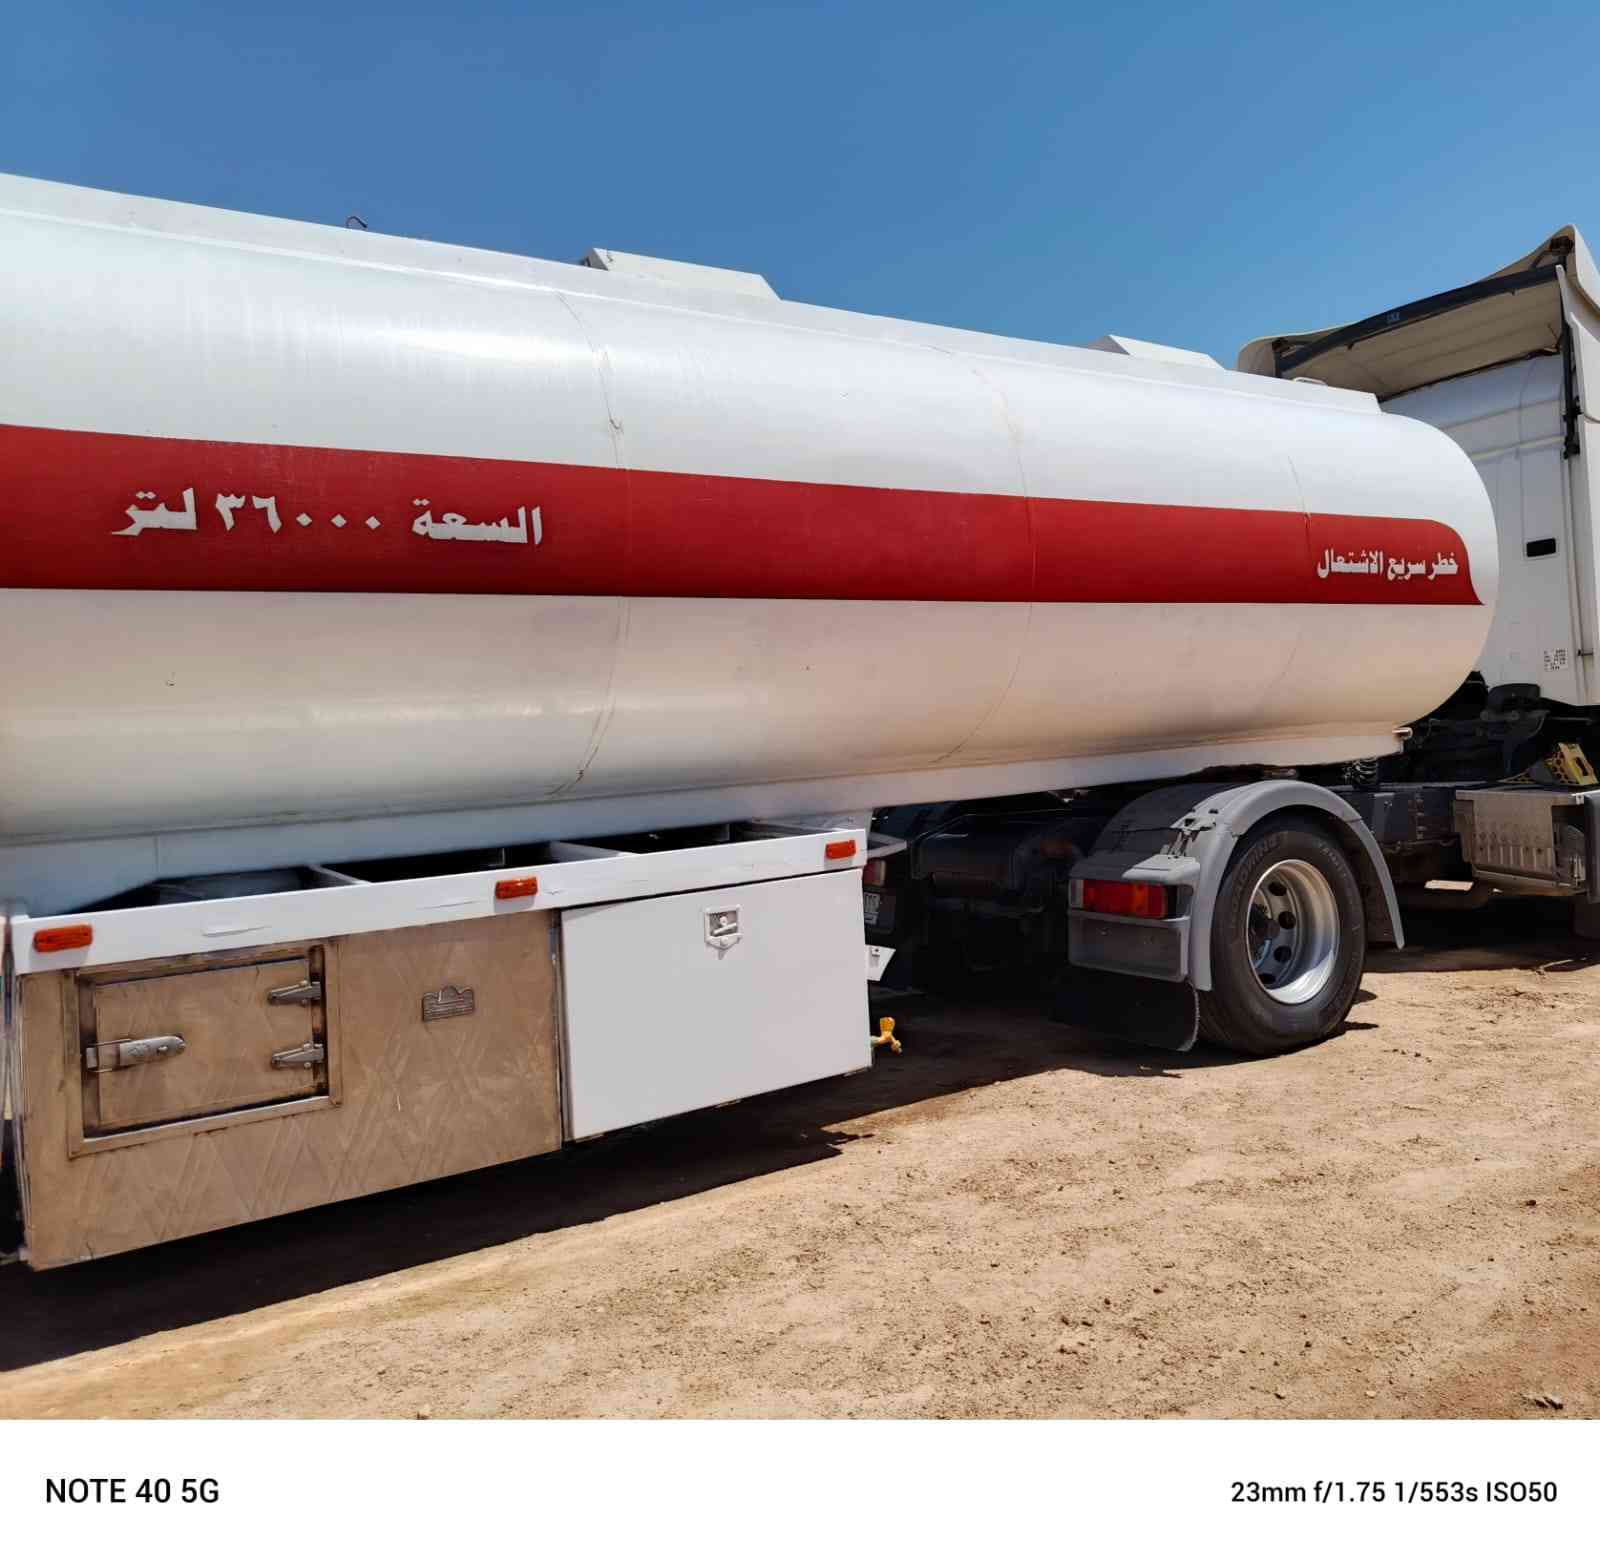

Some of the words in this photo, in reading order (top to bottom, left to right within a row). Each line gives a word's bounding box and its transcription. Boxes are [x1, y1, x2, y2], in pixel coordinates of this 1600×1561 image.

[112, 488, 196, 535] لتر
[215, 493, 381, 533] ٣٦٠٠٠
[412, 498, 542, 544] السعة
[1317, 549, 1383, 578] الاشتعال
[1387, 556, 1425, 580] سريع
[1427, 552, 1459, 580] خطر
